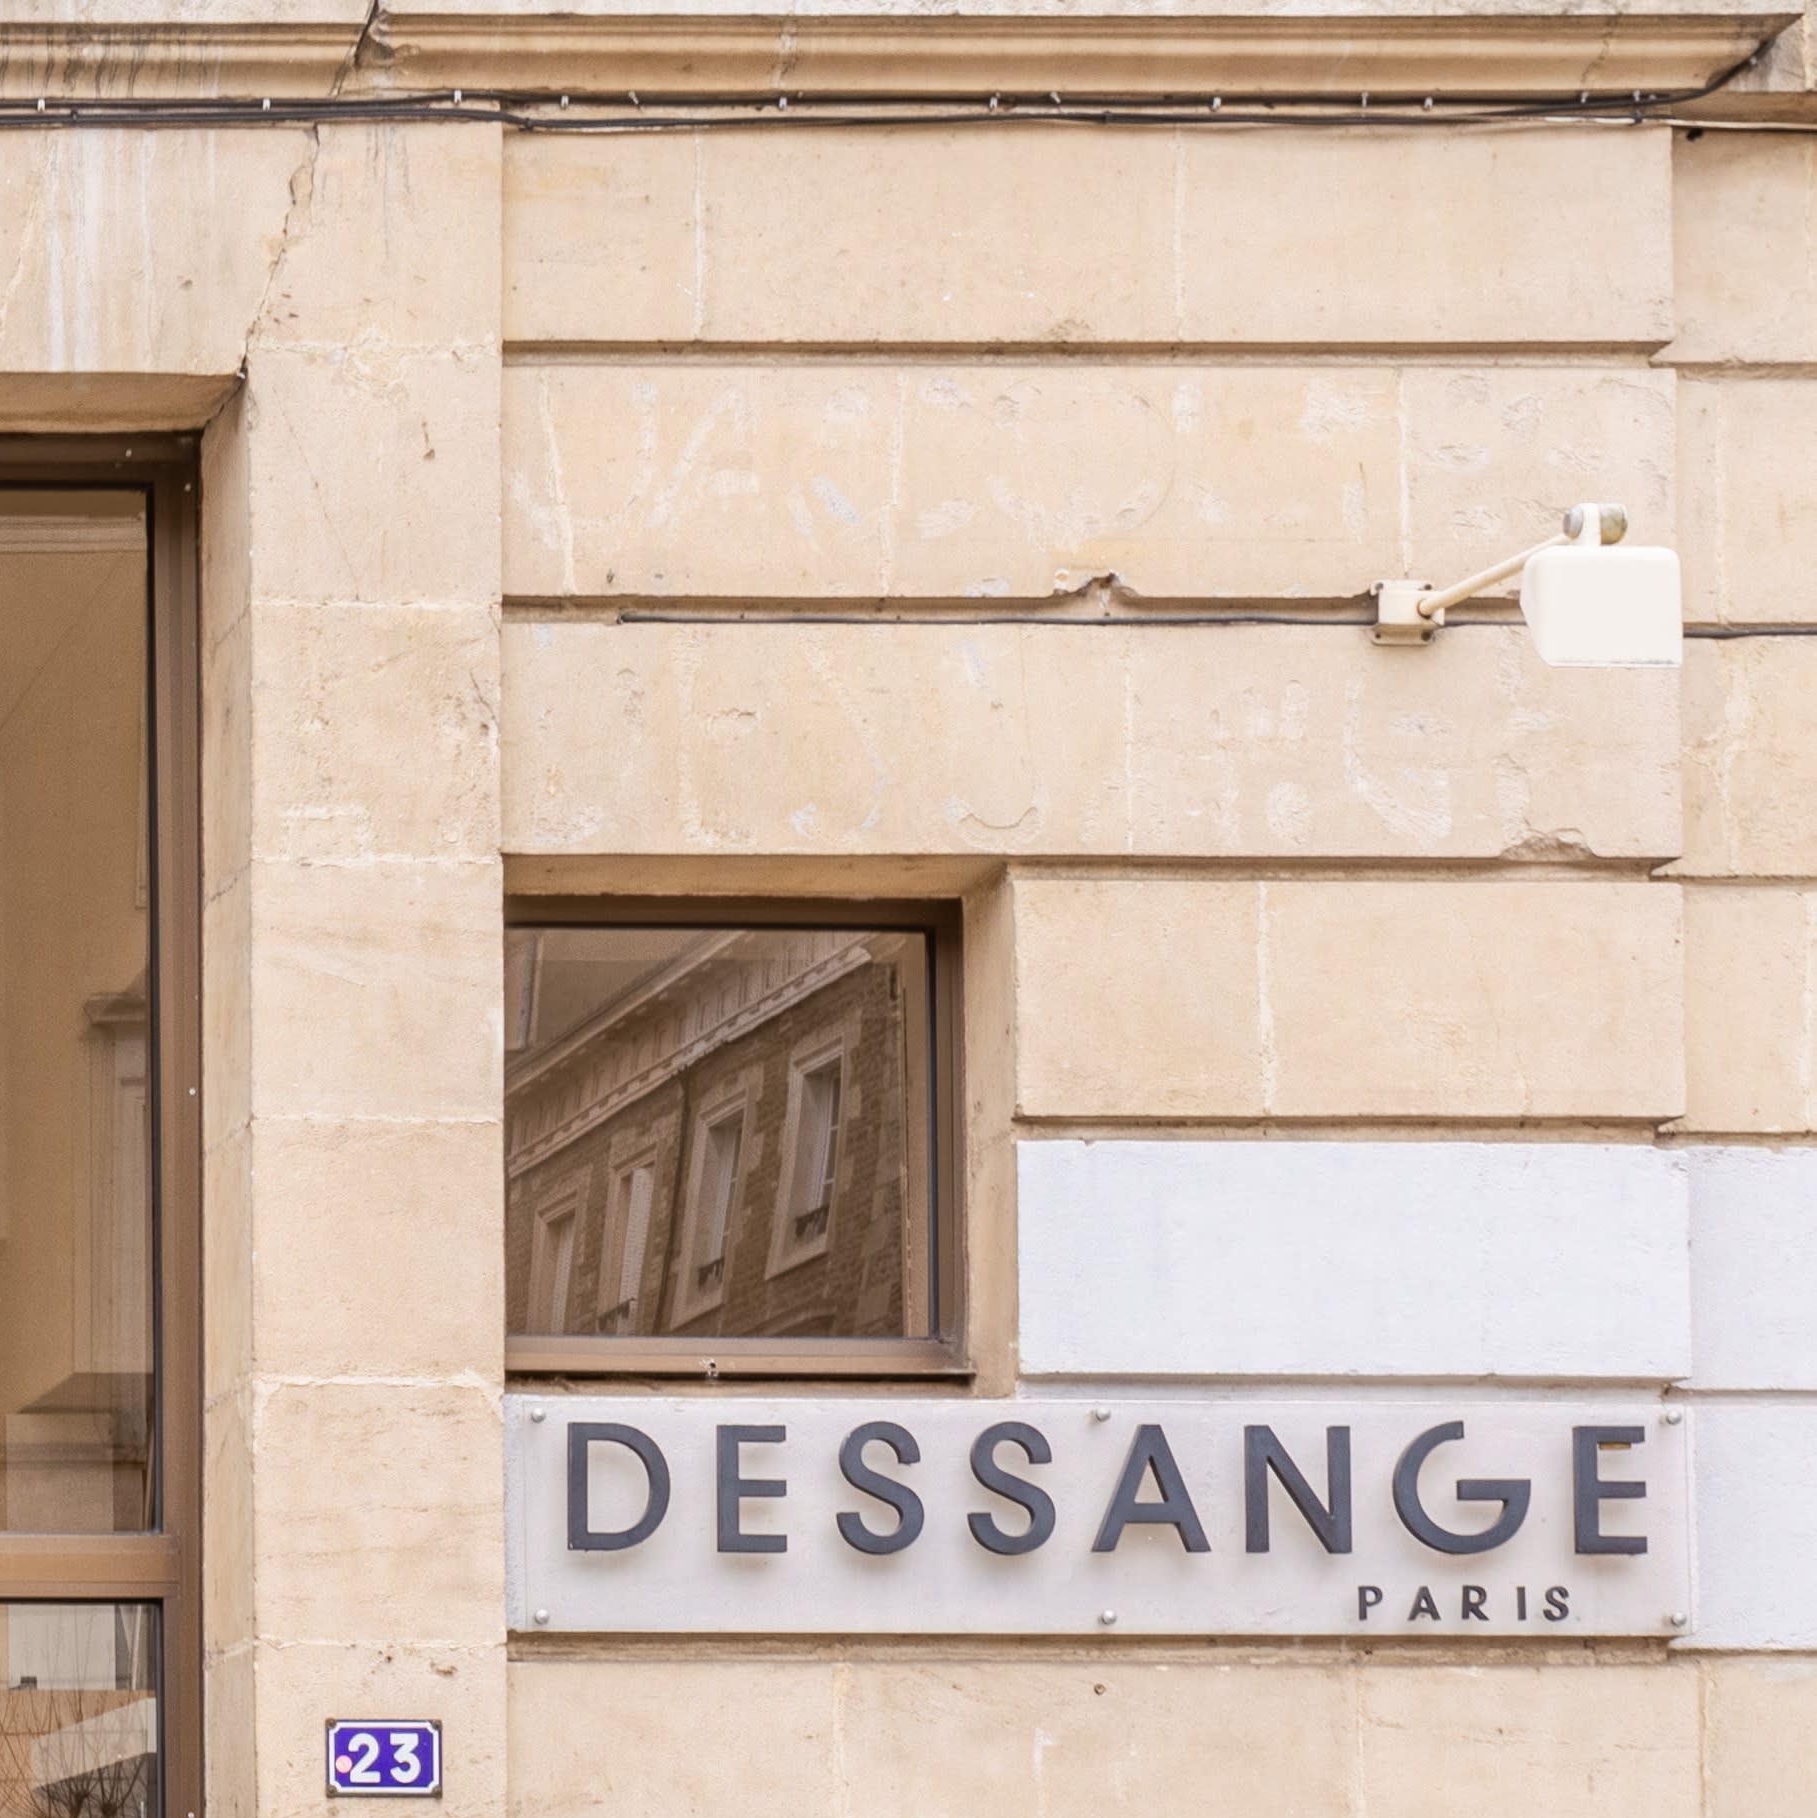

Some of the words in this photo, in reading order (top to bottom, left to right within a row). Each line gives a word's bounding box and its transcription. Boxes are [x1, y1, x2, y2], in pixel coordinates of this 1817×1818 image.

[565, 1420, 1649, 1557] DESSANGE
[1358, 1584, 1573, 1624] PARIS
[348, 1732, 422, 1785] 23
